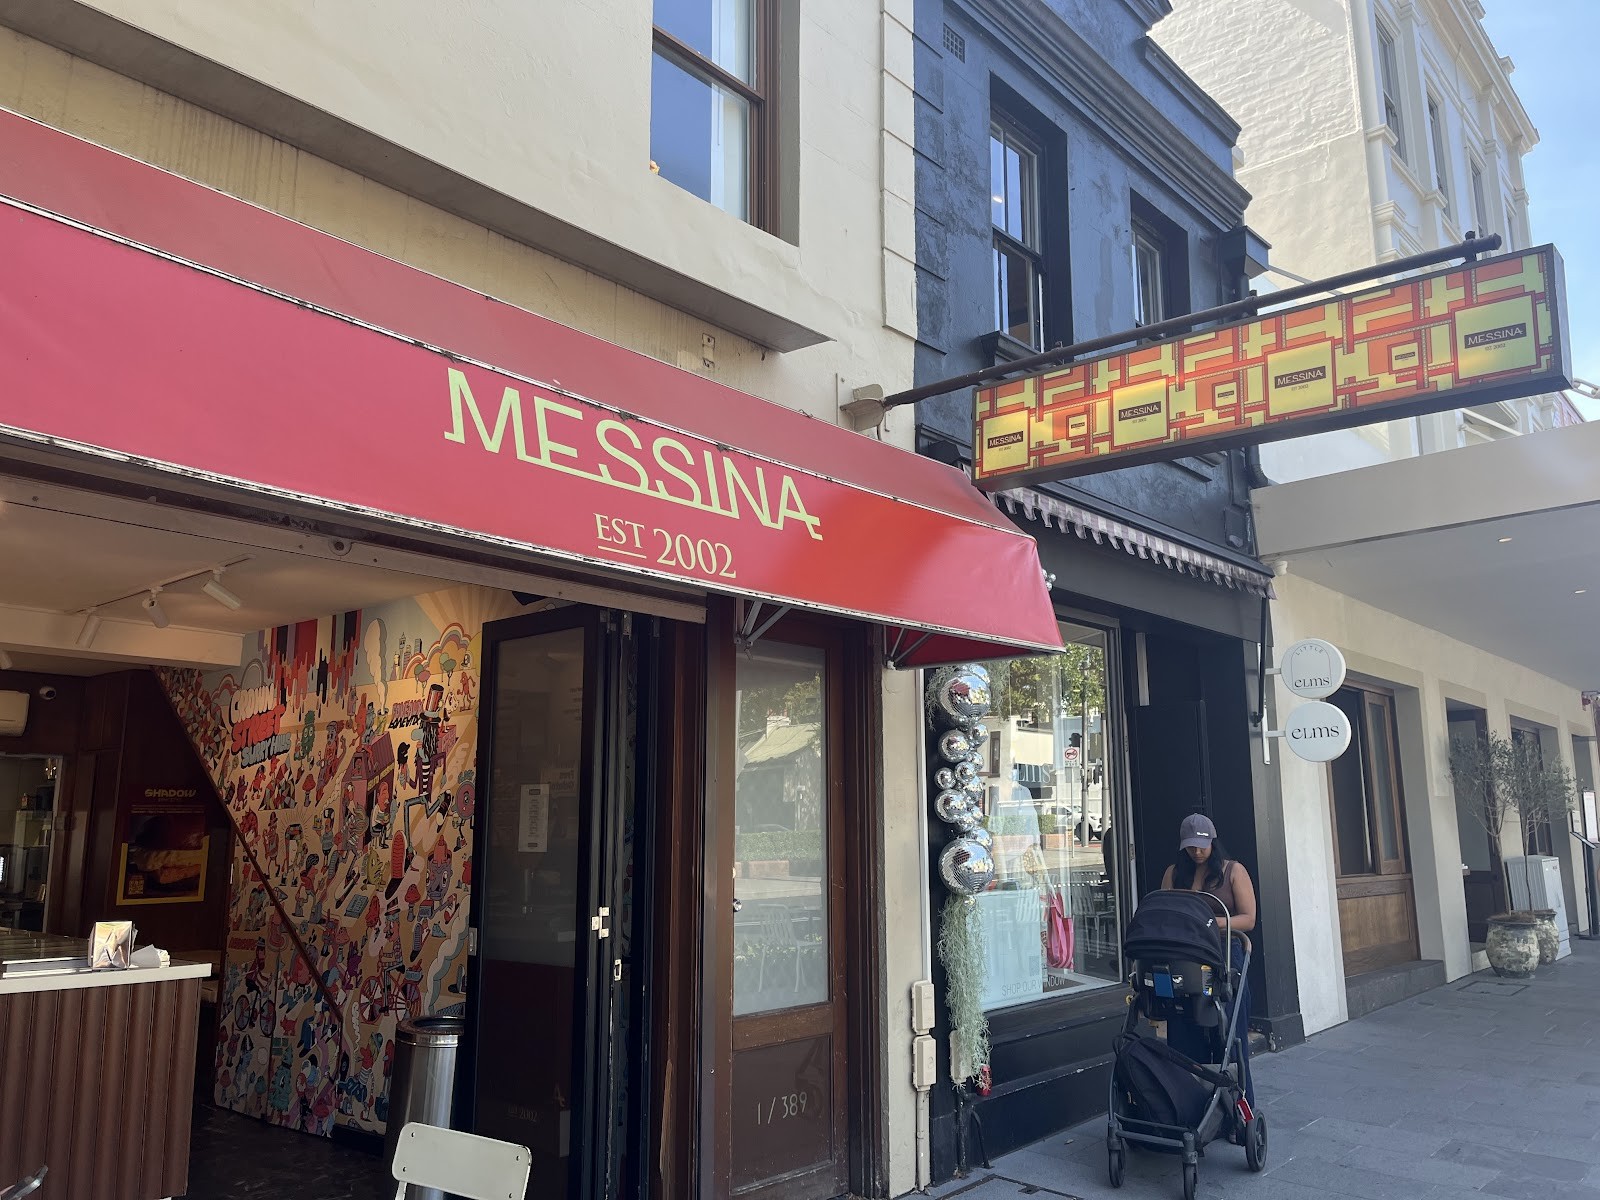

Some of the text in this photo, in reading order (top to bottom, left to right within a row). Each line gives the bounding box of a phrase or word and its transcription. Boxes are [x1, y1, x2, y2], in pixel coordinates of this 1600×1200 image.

[1467, 327, 1523, 346] MESSINA
[1277, 369, 1324, 386] MESSINA
[1120, 404, 1159, 419] MESSINA
[989, 433, 1022, 447] MESSINA
[444, 367, 823, 541] MESSINA
[593, 513, 737, 579] EST 2002
[1295, 645, 1324, 656] LITTLE
[230, 682, 275, 724] CROWN
[231, 704, 286, 754] STREET
[144, 788, 197, 798] SHADOW
[1001, 981, 1021, 997] SHOP
